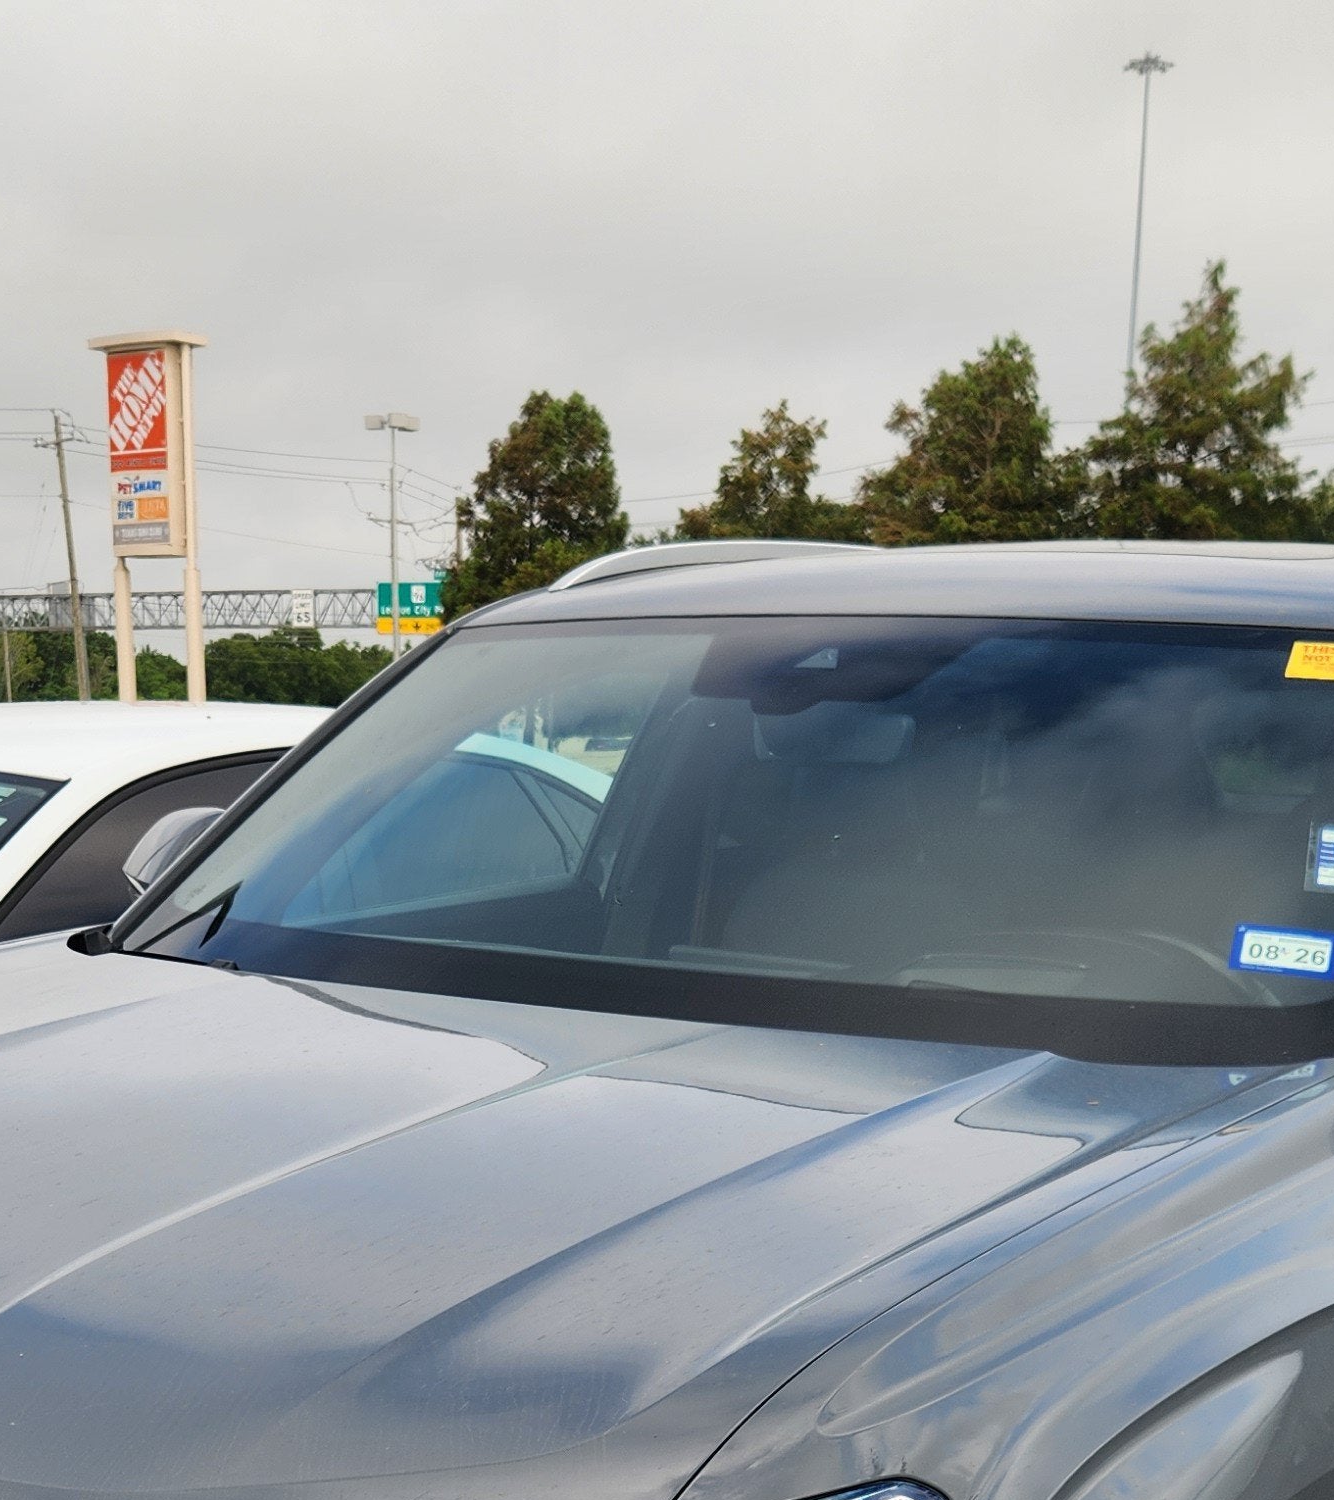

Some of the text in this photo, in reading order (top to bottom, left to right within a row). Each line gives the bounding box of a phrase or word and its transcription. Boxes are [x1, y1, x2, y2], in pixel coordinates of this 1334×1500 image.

[111, 362, 137, 403] THE
[110, 352, 166, 451] HOME
[131, 388, 167, 450] DEPOT
[297, 611, 311, 623] 65
[1302, 654, 1331, 662] NOT
[1249, 943, 1326, 965] 08 26
